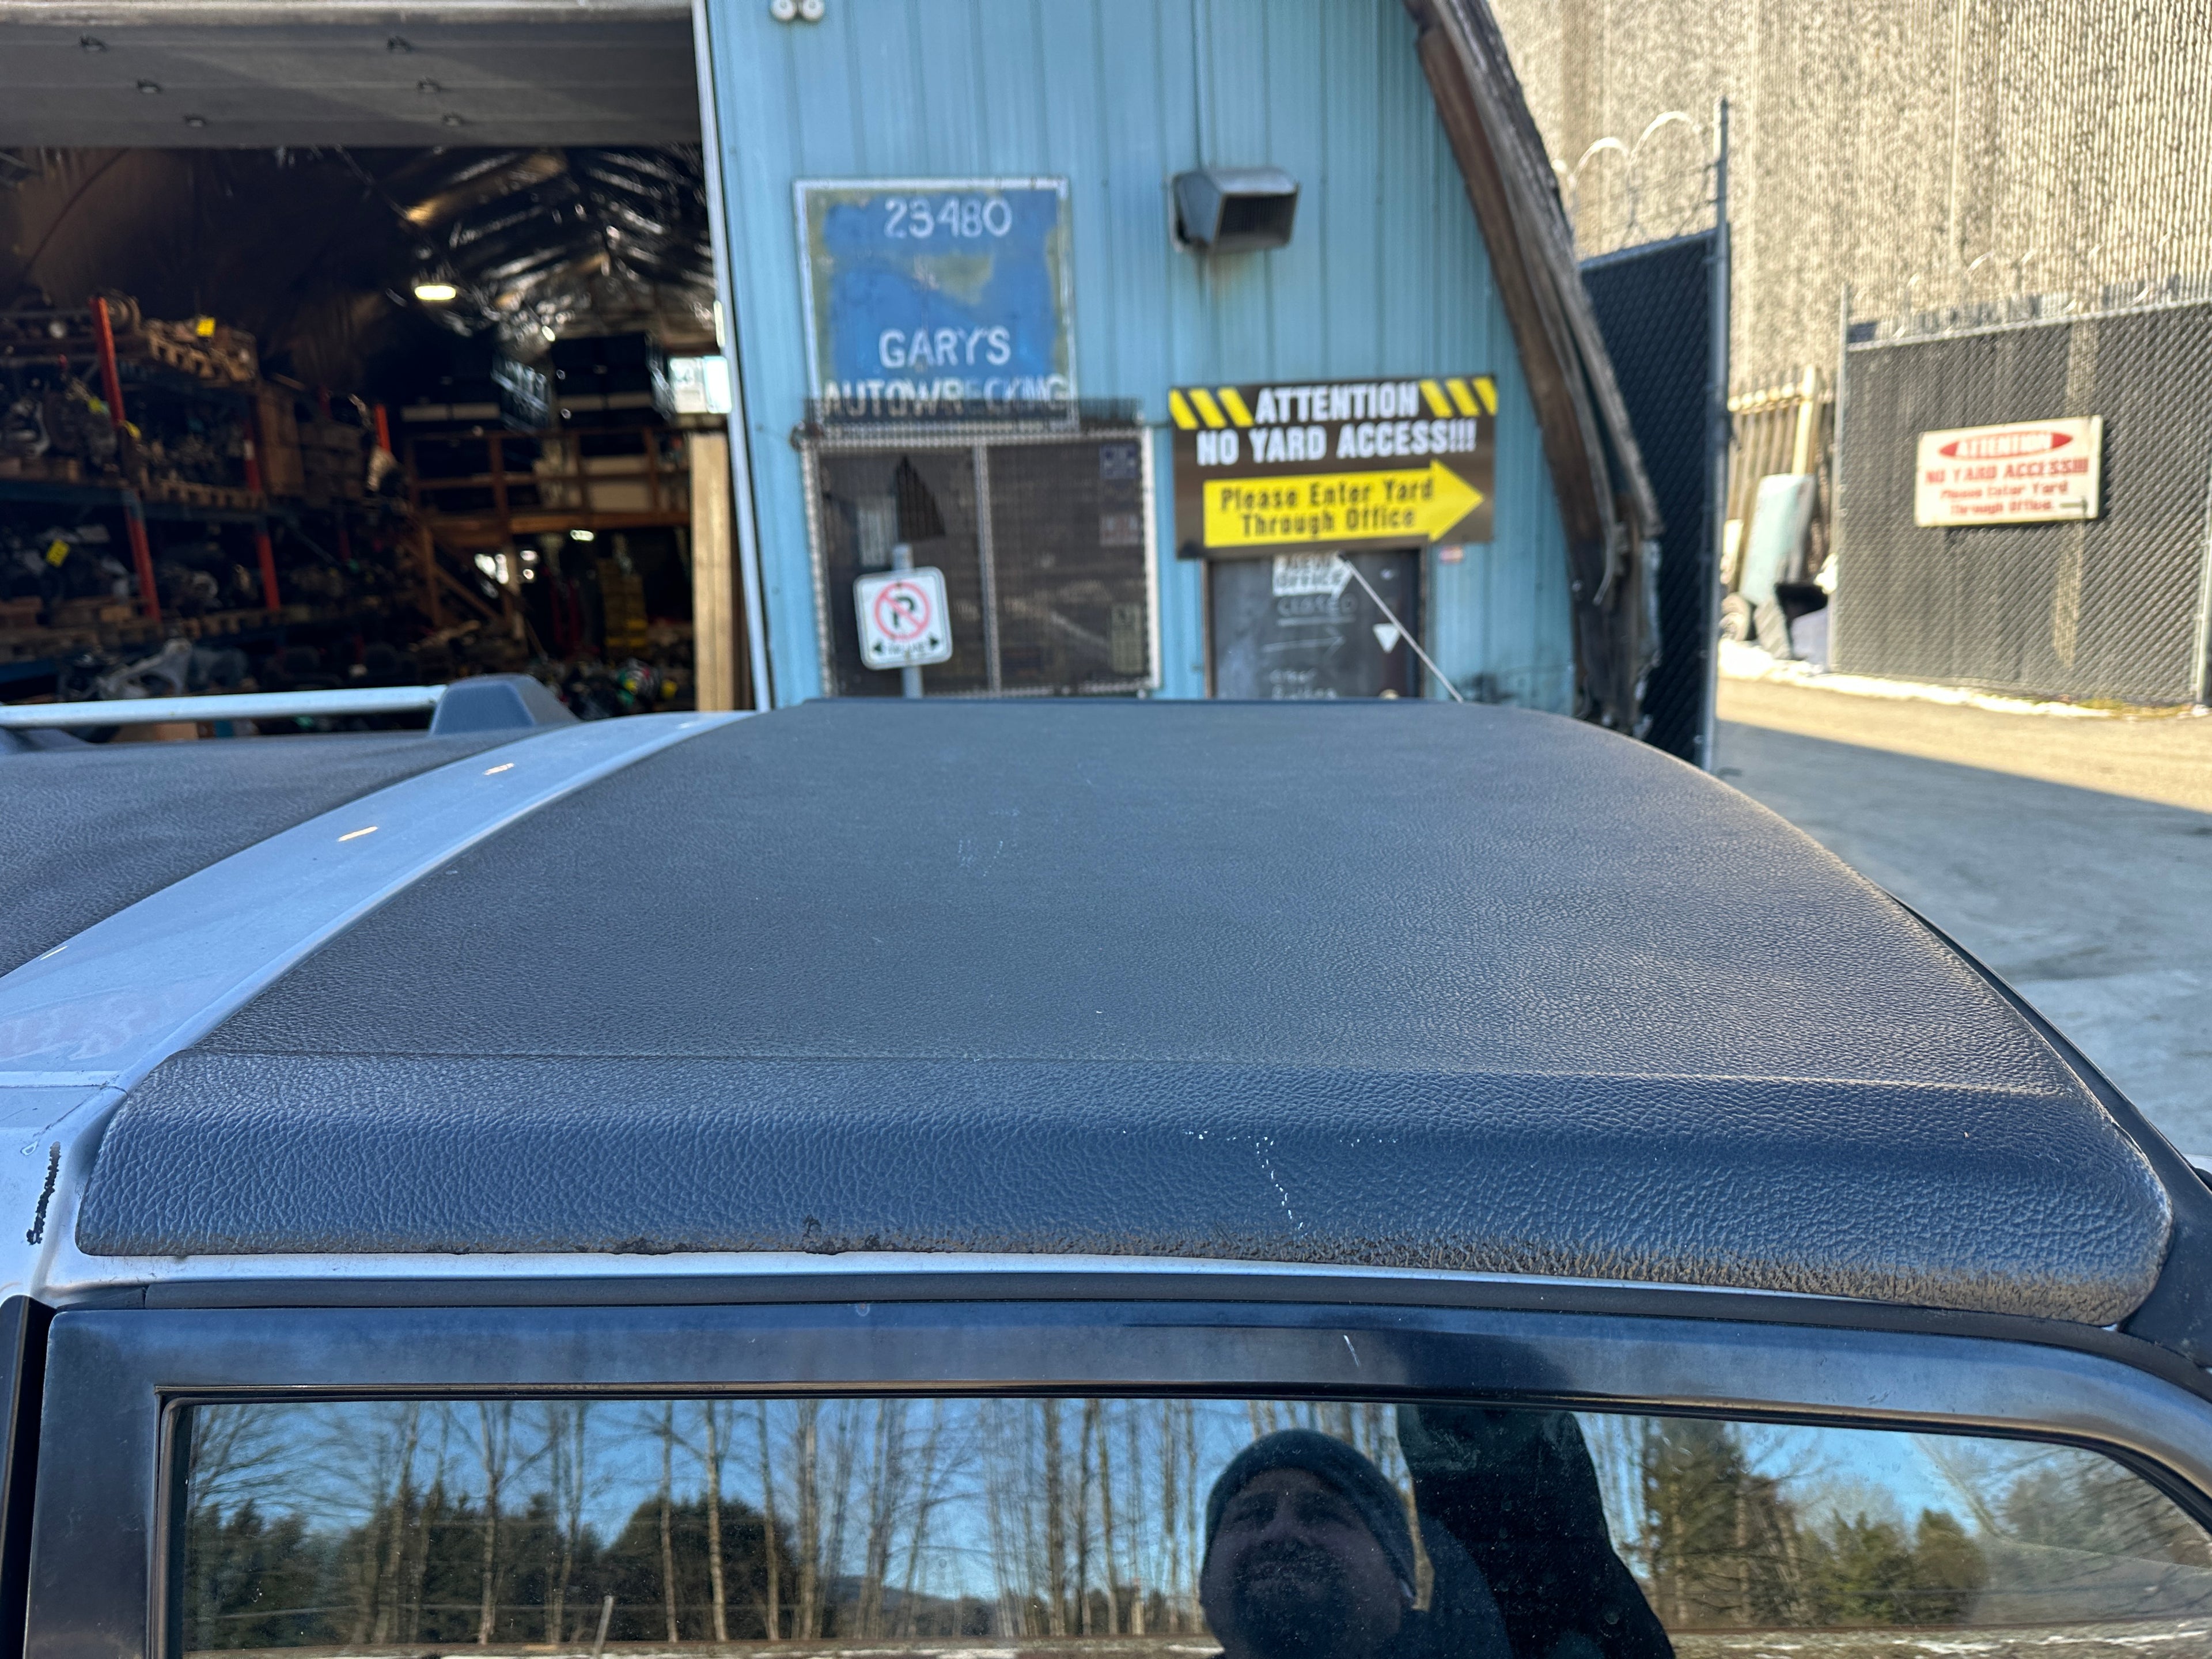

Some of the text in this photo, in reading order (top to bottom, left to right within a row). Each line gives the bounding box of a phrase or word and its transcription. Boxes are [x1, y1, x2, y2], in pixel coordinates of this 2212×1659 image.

[884, 197, 1012, 238] 23480
[1255, 381, 1419, 425] ATTENTION
[1196, 419, 1477, 466] NO YARD ACCESS!!!
[1955, 434, 2051, 457] ATTENTION
[1953, 465, 1998, 483] YARD
[2032, 480, 2068, 494] Yard
[1221, 478, 1433, 512] Please Enter Yard
[1242, 505, 1414, 540] Through Office
